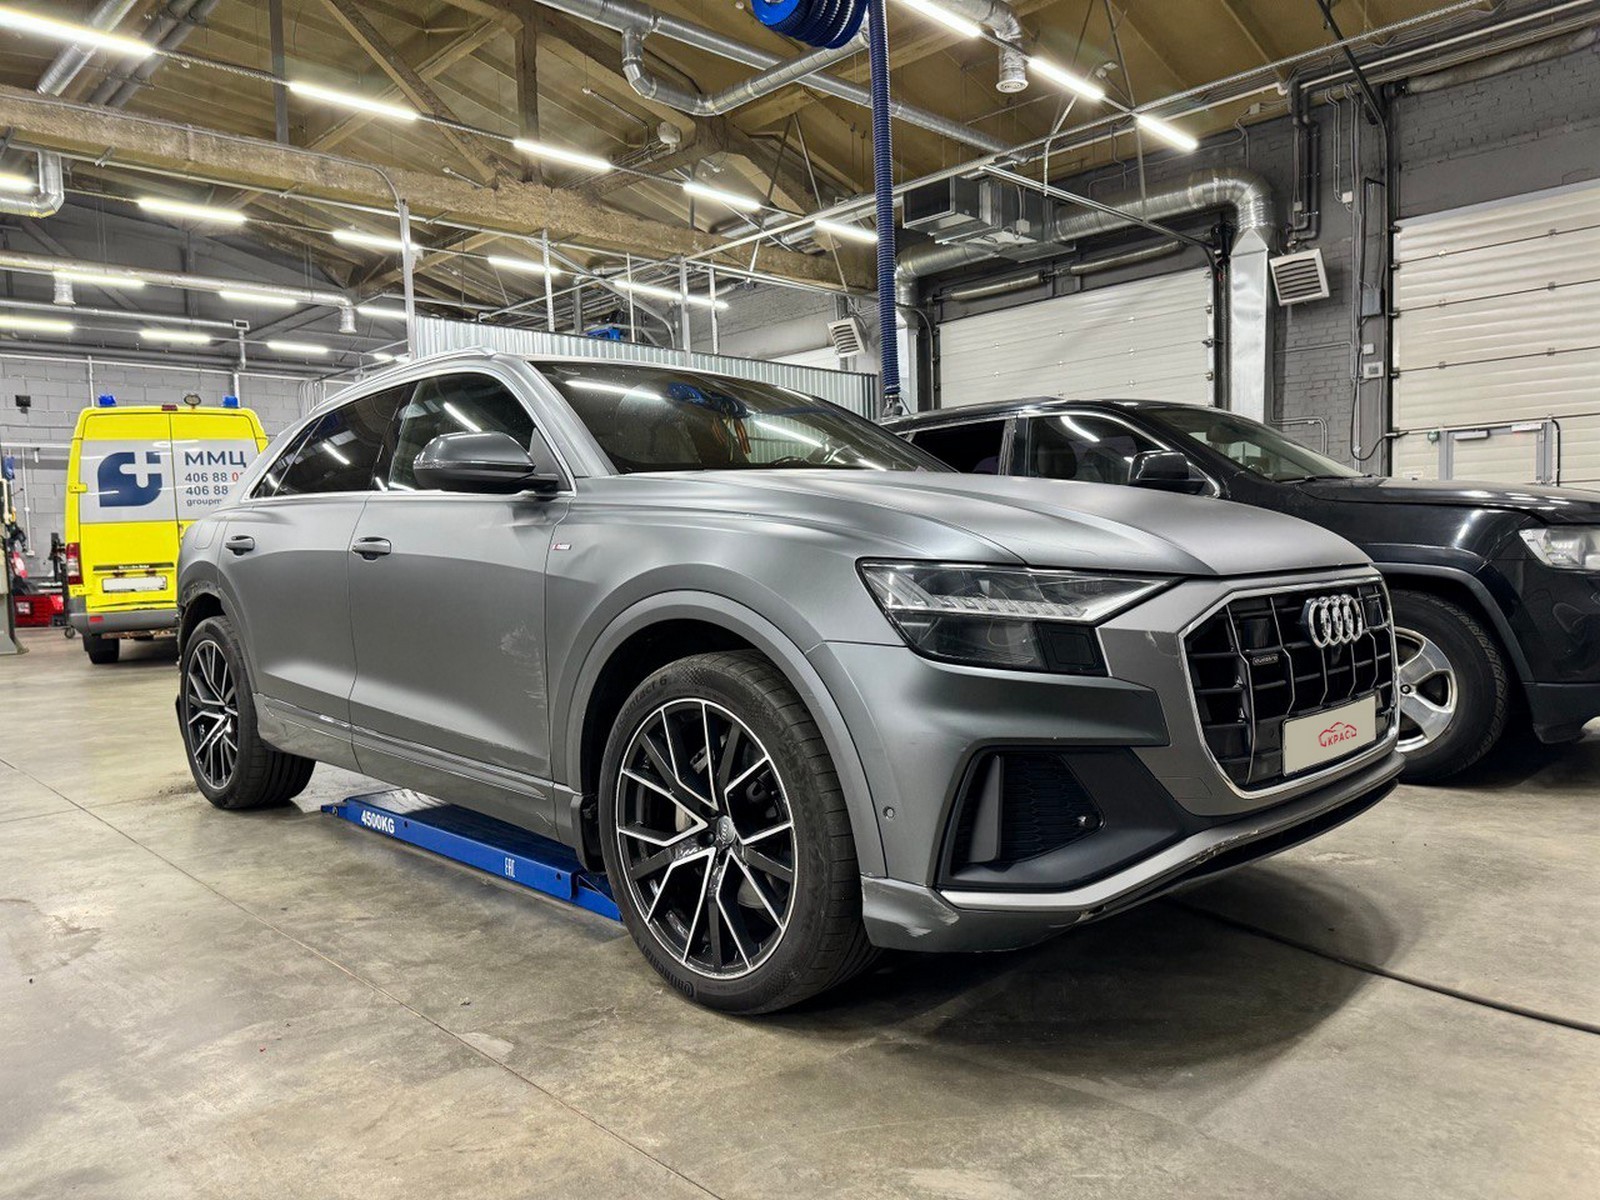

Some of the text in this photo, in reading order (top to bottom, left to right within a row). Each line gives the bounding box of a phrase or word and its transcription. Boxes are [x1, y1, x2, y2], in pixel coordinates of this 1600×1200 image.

[185, 450, 247, 468] ММЦ
[185, 471, 244, 483] 406 88 0
[186, 485, 229, 496] 406 88
[361, 809, 395, 835] 4500KG
